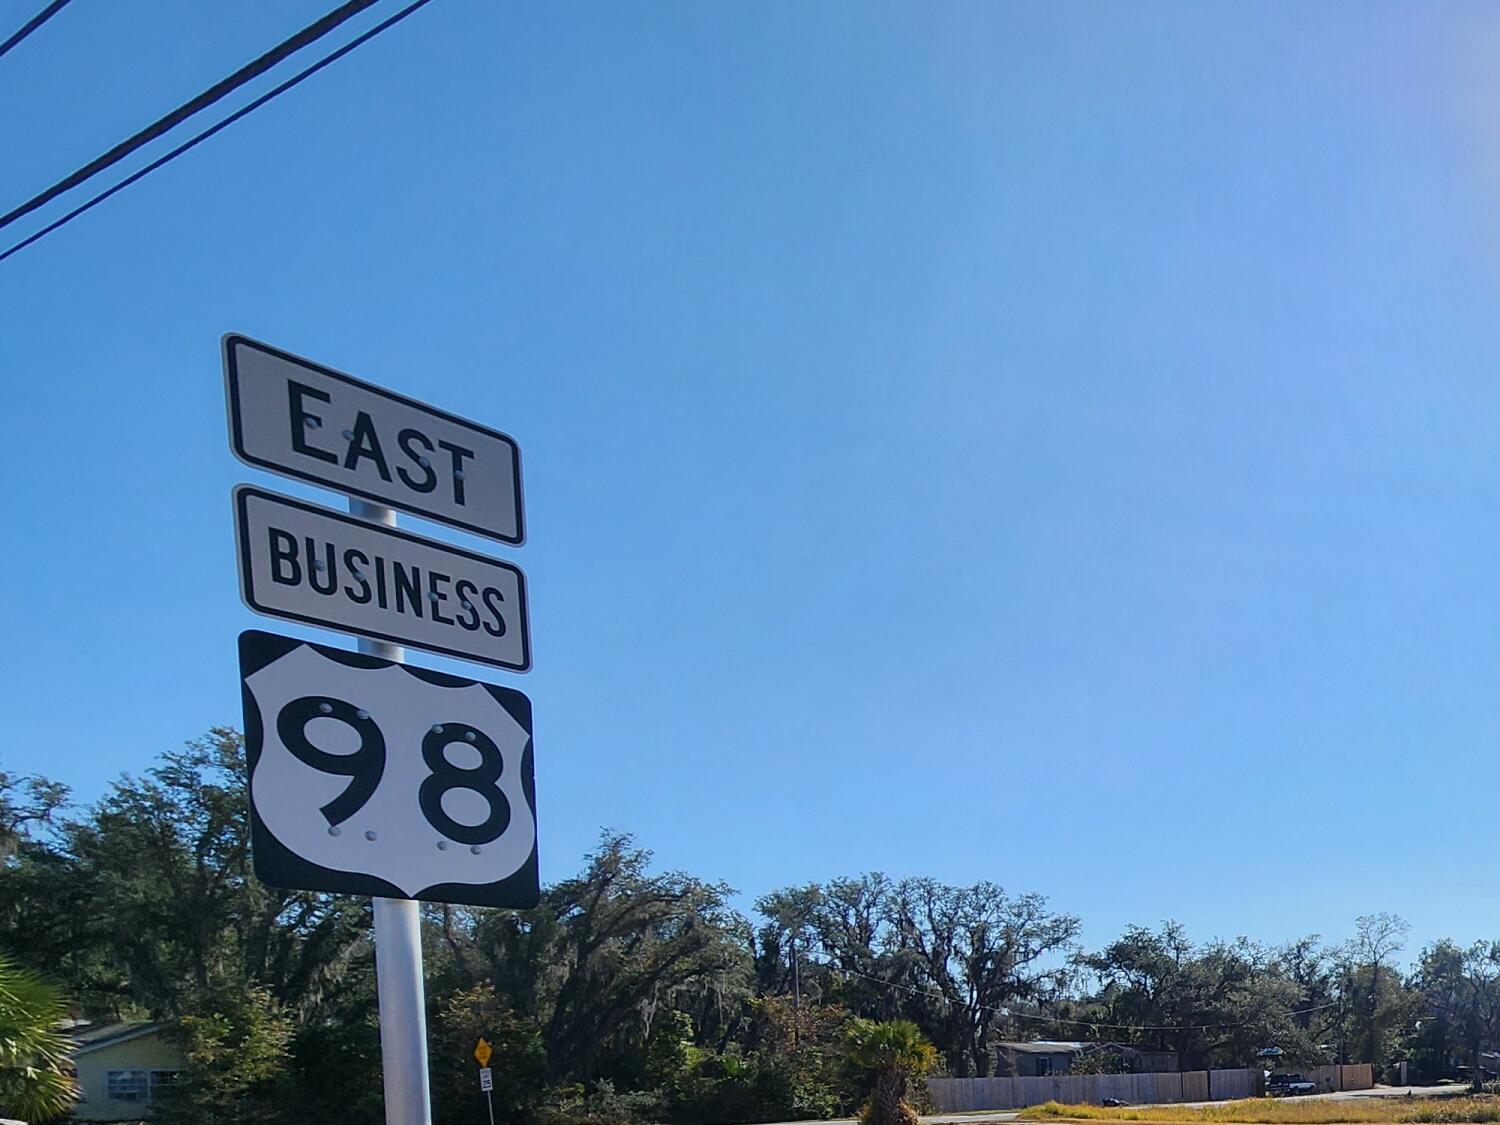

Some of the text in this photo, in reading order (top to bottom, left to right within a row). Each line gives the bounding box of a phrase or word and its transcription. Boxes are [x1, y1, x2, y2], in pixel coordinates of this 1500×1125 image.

[287, 379, 475, 505] EAST
[268, 527, 507, 638] BUSINESS
[276, 695, 511, 845] 98
